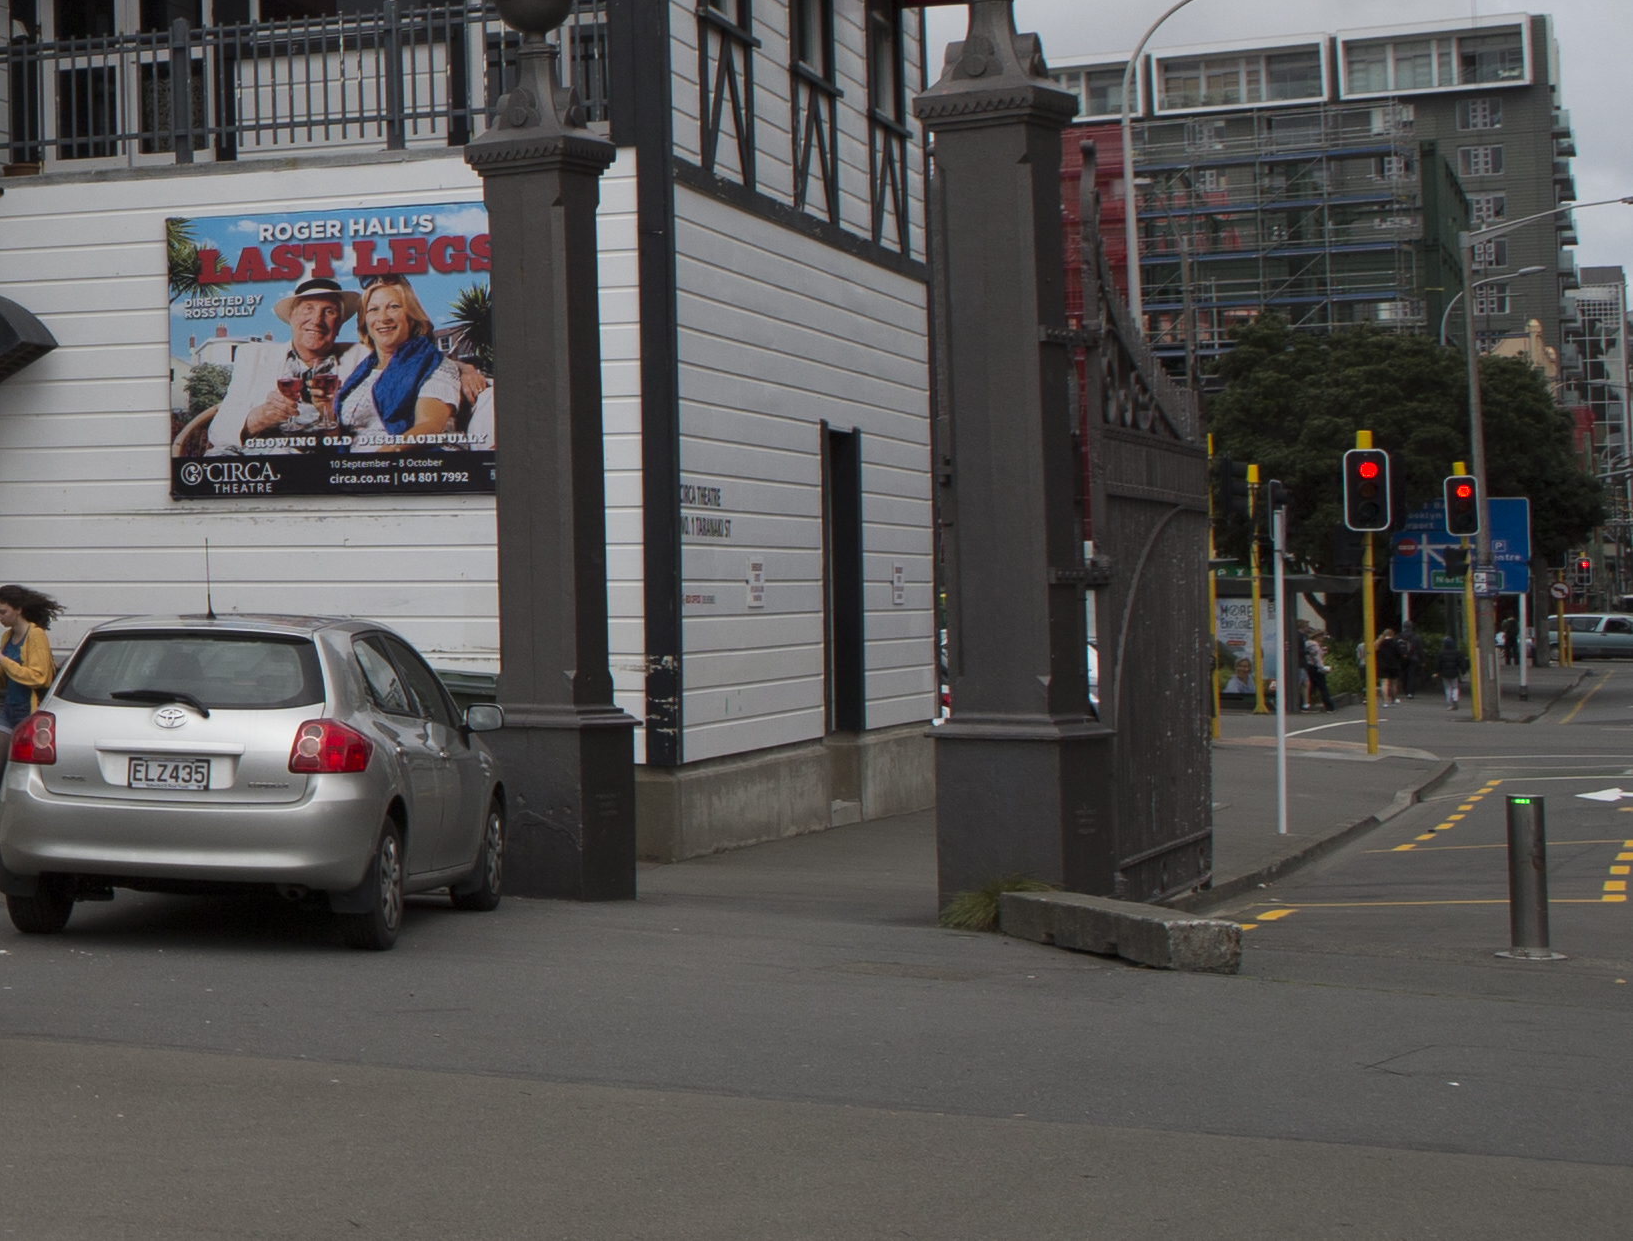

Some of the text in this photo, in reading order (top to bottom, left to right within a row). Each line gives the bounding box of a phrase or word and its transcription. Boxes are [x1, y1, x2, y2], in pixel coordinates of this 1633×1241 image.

[259, 220, 342, 242] ROGER
[198, 234, 491, 284] LAST LEGS
[184, 294, 263, 308] DIRECTED BY
[185, 306, 255, 319] ROSS JOLLY
[245, 433, 489, 448] GROWING OLD DISGRACEFULLY
[330, 460, 340, 469] 10
[342, 459, 390, 470] September
[406, 458, 443, 467] October
[202, 461, 281, 482] CIRCA
[330, 473, 390, 484] circa.co.nz
[402, 473, 416, 482] 04
[418, 472, 438, 482] 801
[441, 472, 469, 482] 7992
[214, 483, 273, 494] THEATRE
[132, 763, 205, 784] ELZ435
